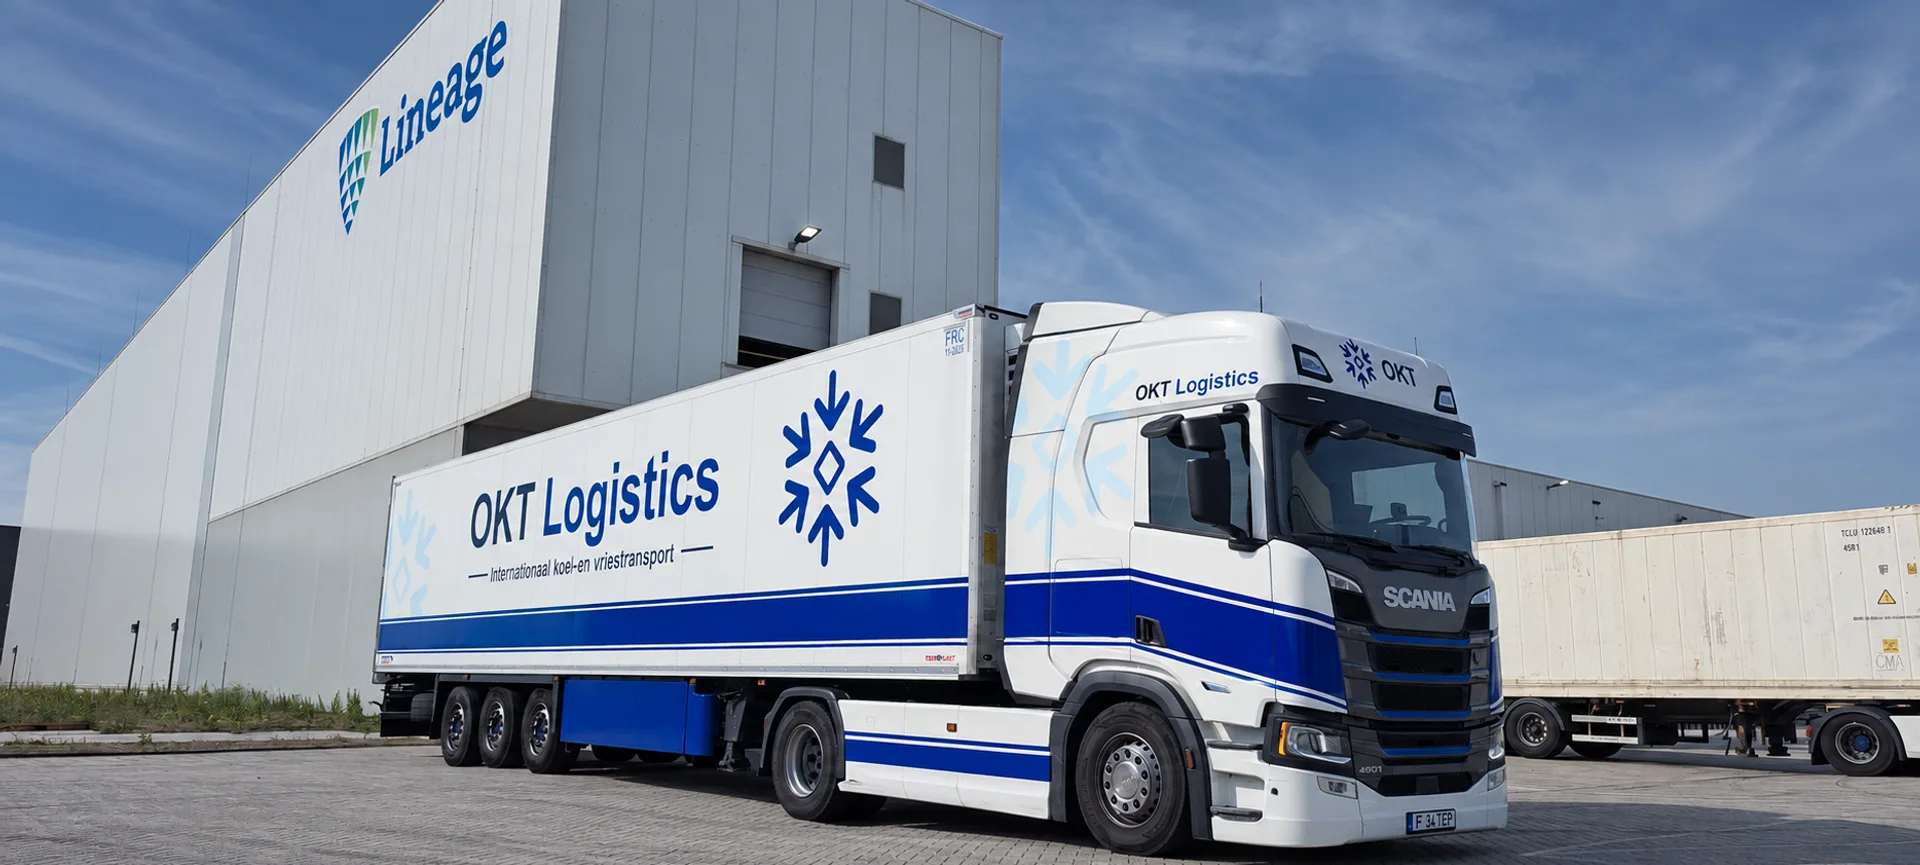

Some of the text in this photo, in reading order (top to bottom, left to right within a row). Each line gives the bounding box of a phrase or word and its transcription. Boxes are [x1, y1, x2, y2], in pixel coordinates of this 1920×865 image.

[379, 20, 508, 177] Lineage
[945, 327, 965, 347] FRC
[1135, 369, 1260, 402] OKT Logistics
[1381, 359, 1417, 388] OKT
[470, 449, 720, 549] OKT Logistics
[490, 559, 551, 583] Internationaal
[593, 543, 675, 572] vriestransport
[1383, 585, 1457, 612] SCANIA
[1875, 653, 1905, 669] CMA
